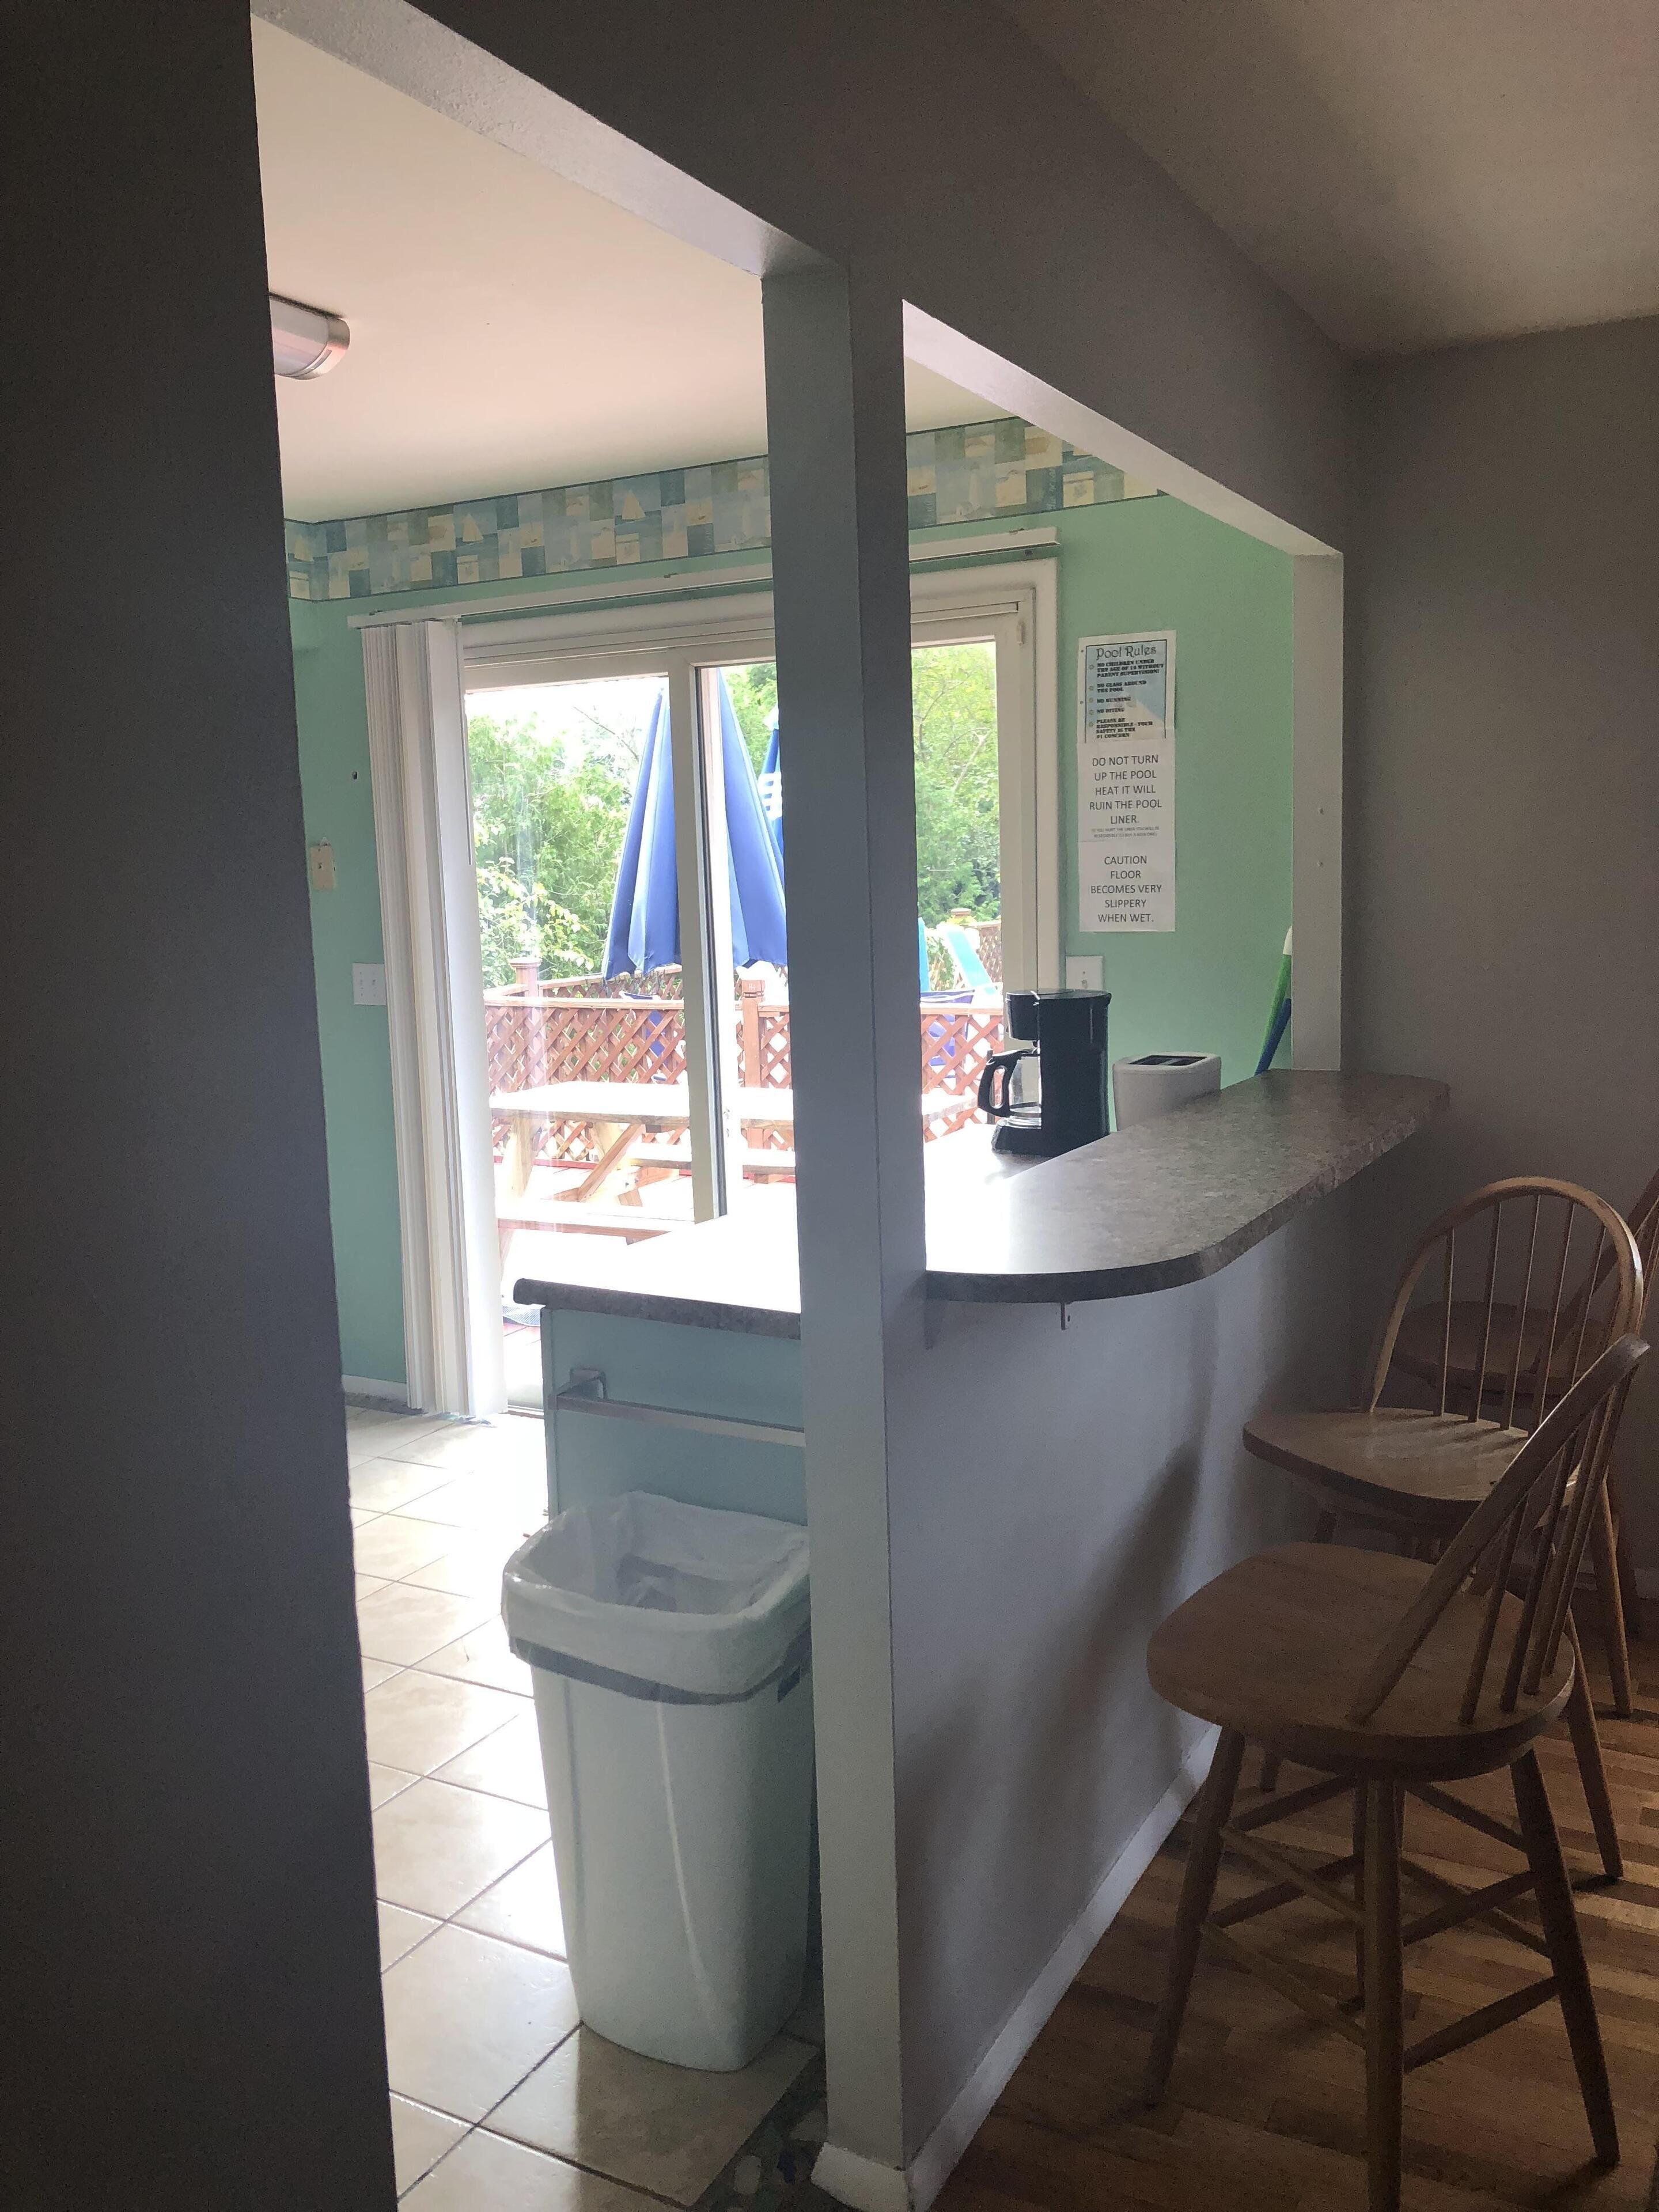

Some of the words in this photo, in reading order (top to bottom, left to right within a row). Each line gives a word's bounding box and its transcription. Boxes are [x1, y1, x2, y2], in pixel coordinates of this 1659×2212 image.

[1096, 647, 1122, 660] Pool
[1125, 645, 1156, 657] Rules
[1092, 757, 1105, 767] DO
[1109, 756, 1128, 766] NOT
[1131, 755, 1158, 764] TURN
[1094, 772, 1107, 781] UP
[1110, 771, 1128, 780] THE
[1131, 770, 1156, 779] POOL
[1095, 786, 1119, 795] HEAT
[1122, 786, 1130, 794] IT
[1133, 785, 1156, 794] WILL
[1090, 801, 1112, 810] RUIN
[1136, 800, 1162, 808] POOL
[1111, 815, 1139, 824] LINER.
[1104, 856, 1147, 865] CAUTION
[1111, 870, 1141, 879] FLOOR
[1091, 885, 1135, 893] BECOMES
[1138, 884, 1162, 893] VERY
[1105, 899, 1146, 908] SLIPPERY
[1098, 914, 1127, 922] WHEN
[1130, 914, 1154, 922] WET.
